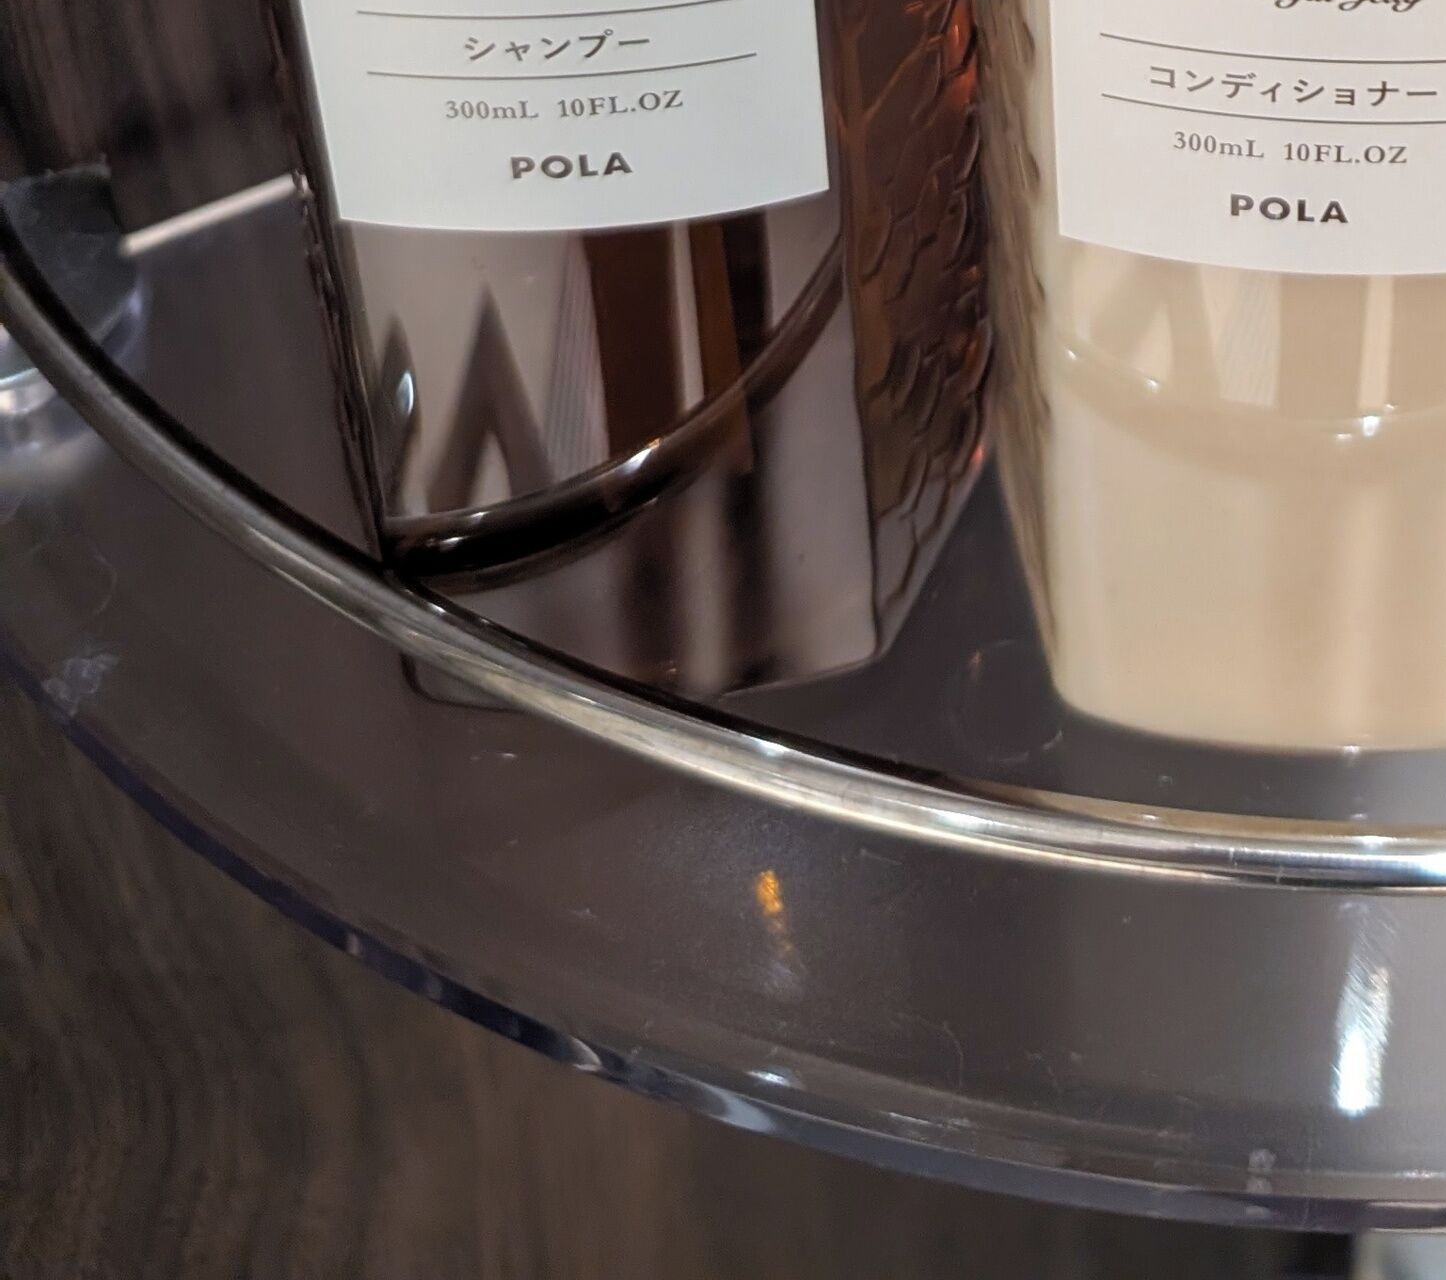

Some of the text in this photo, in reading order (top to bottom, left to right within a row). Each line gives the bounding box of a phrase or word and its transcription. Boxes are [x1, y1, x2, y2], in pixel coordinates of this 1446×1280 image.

[462, 28, 652, 63] シャンプー
[1149, 65, 1439, 108] コンディショナー
[444, 89, 685, 121] 300mL 10FL.OZ
[1172, 130, 1409, 166] 300mL 10FL.OZ
[509, 151, 634, 181] POLA
[1229, 192, 1350, 226] POLA
